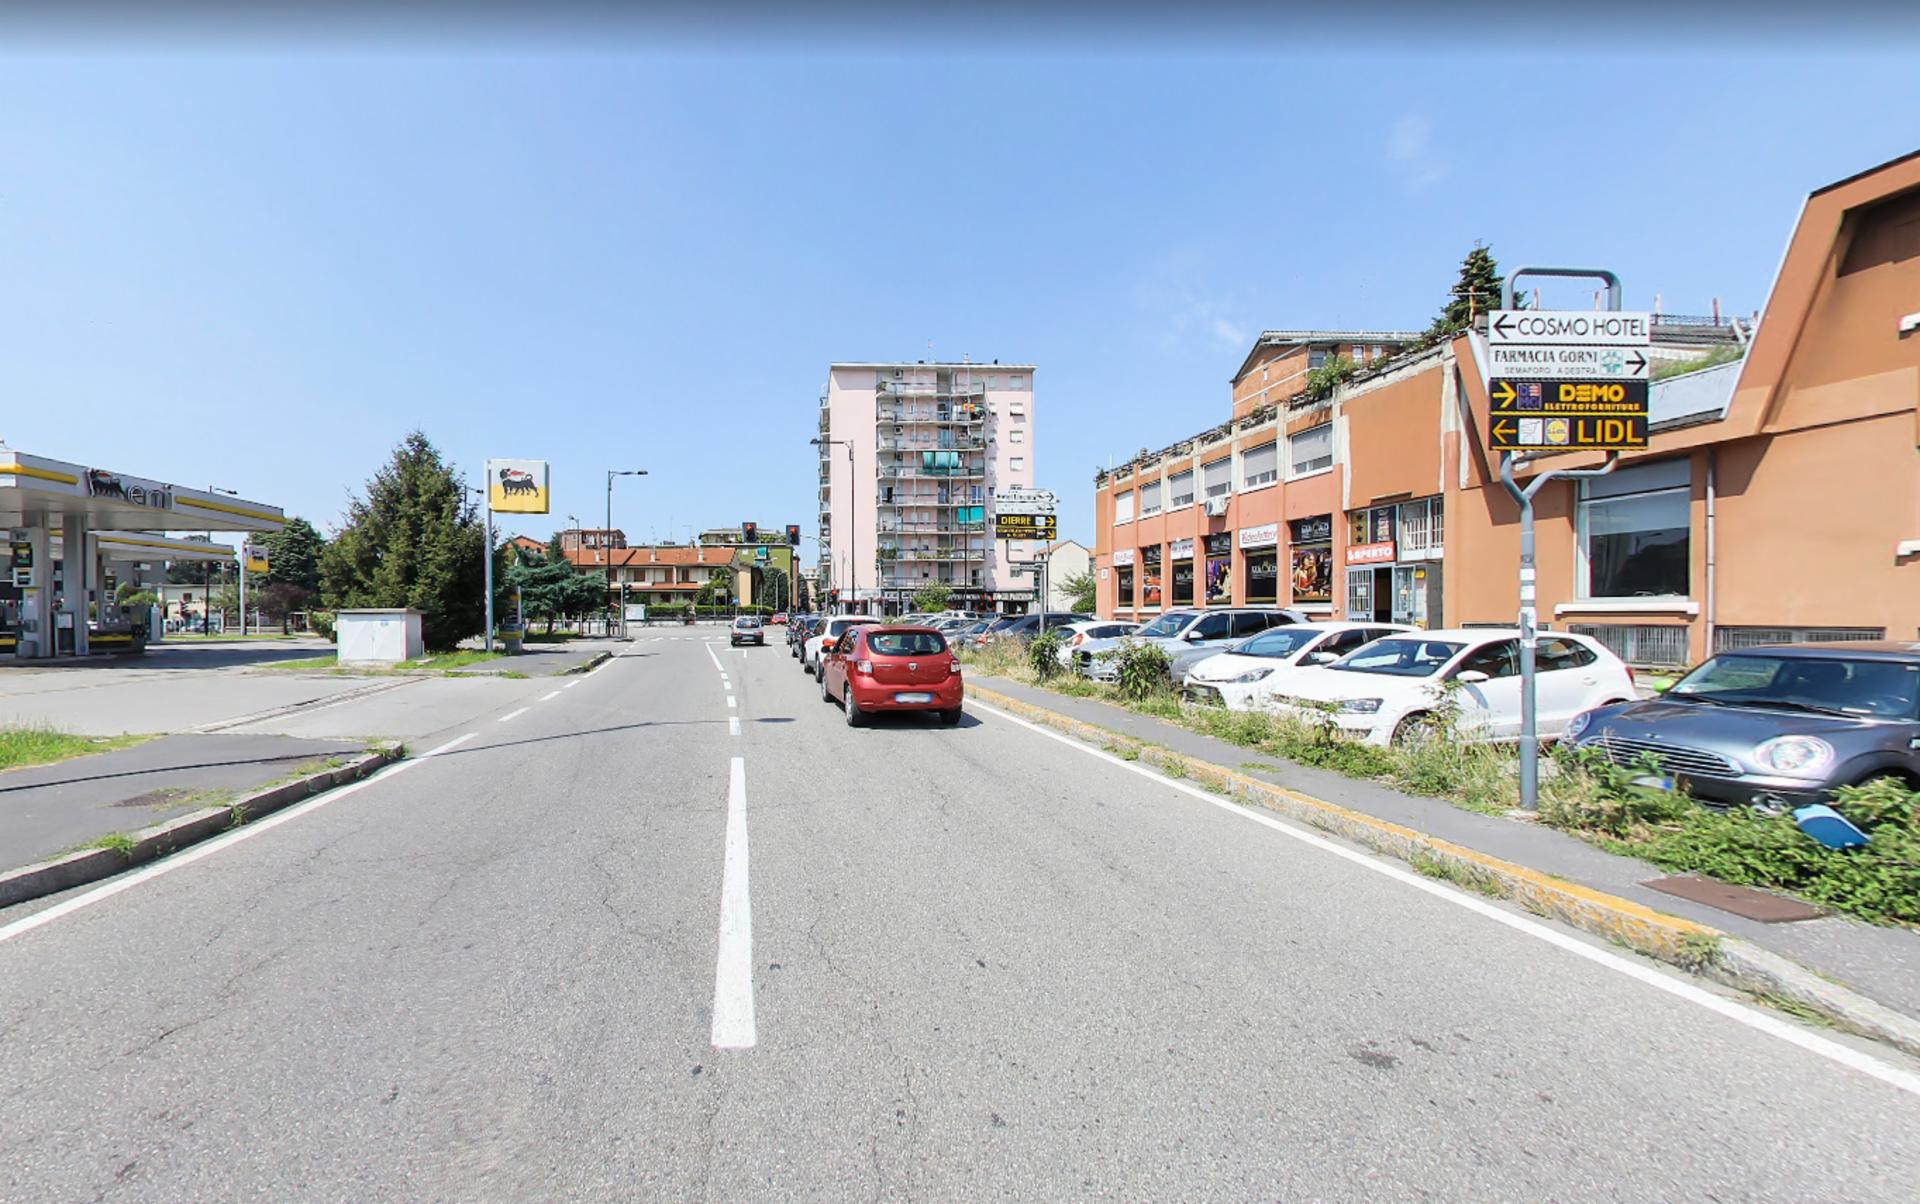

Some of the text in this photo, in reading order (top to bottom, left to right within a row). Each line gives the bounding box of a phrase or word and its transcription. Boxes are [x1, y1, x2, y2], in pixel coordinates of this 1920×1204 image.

[1518, 317, 1647, 336] COSMO HOTEL
[1495, 350, 1598, 363] FARMACIA GORNI
[1504, 367, 1551, 375] SEMAFORO
[1559, 384, 1625, 402] DEMO
[1544, 403, 1641, 411] ELETTROFORNITURE
[1577, 420, 1644, 443] LIDL
[127, 484, 174, 510] eni
